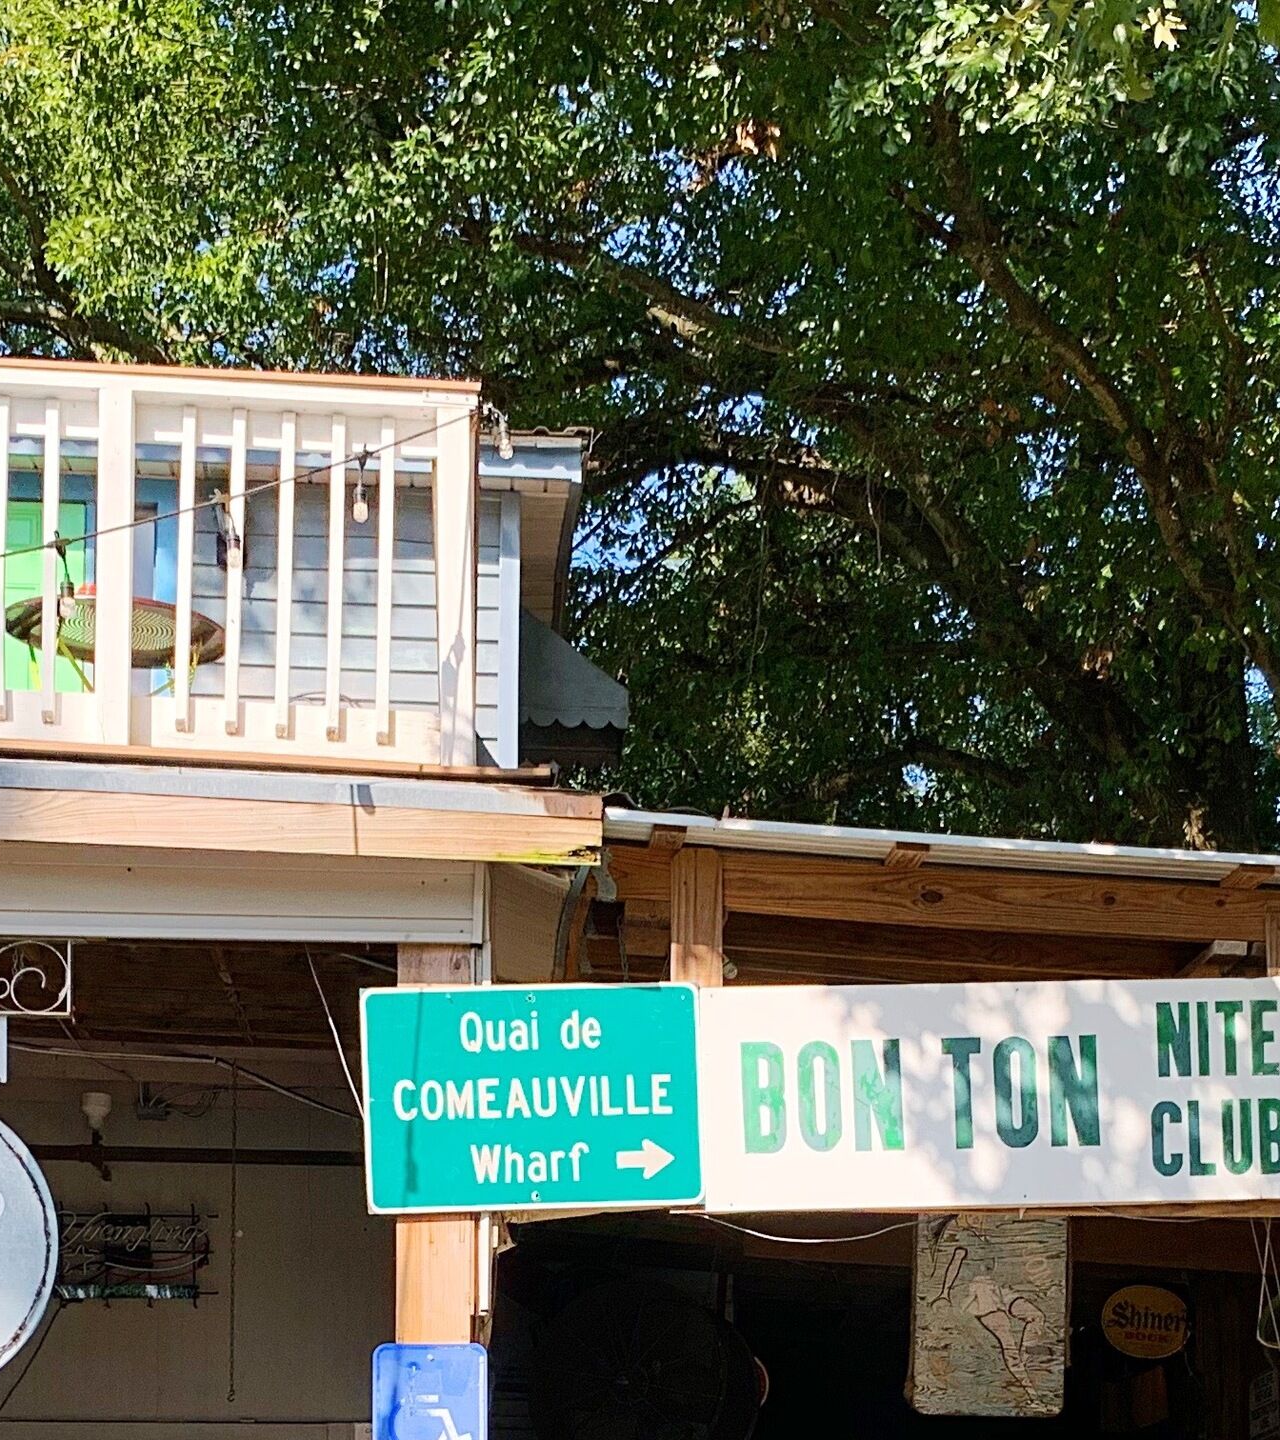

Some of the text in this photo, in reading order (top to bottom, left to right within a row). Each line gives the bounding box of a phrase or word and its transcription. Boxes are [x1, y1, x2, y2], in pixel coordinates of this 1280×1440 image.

[459, 1009, 602, 1053] Quai de
[1155, 1000, 1280, 1078] NITE
[393, 1073, 673, 1122] COMEAUVILLE
[740, 1034, 1101, 1154] BON TON
[470, 1140, 590, 1184] Wharf
